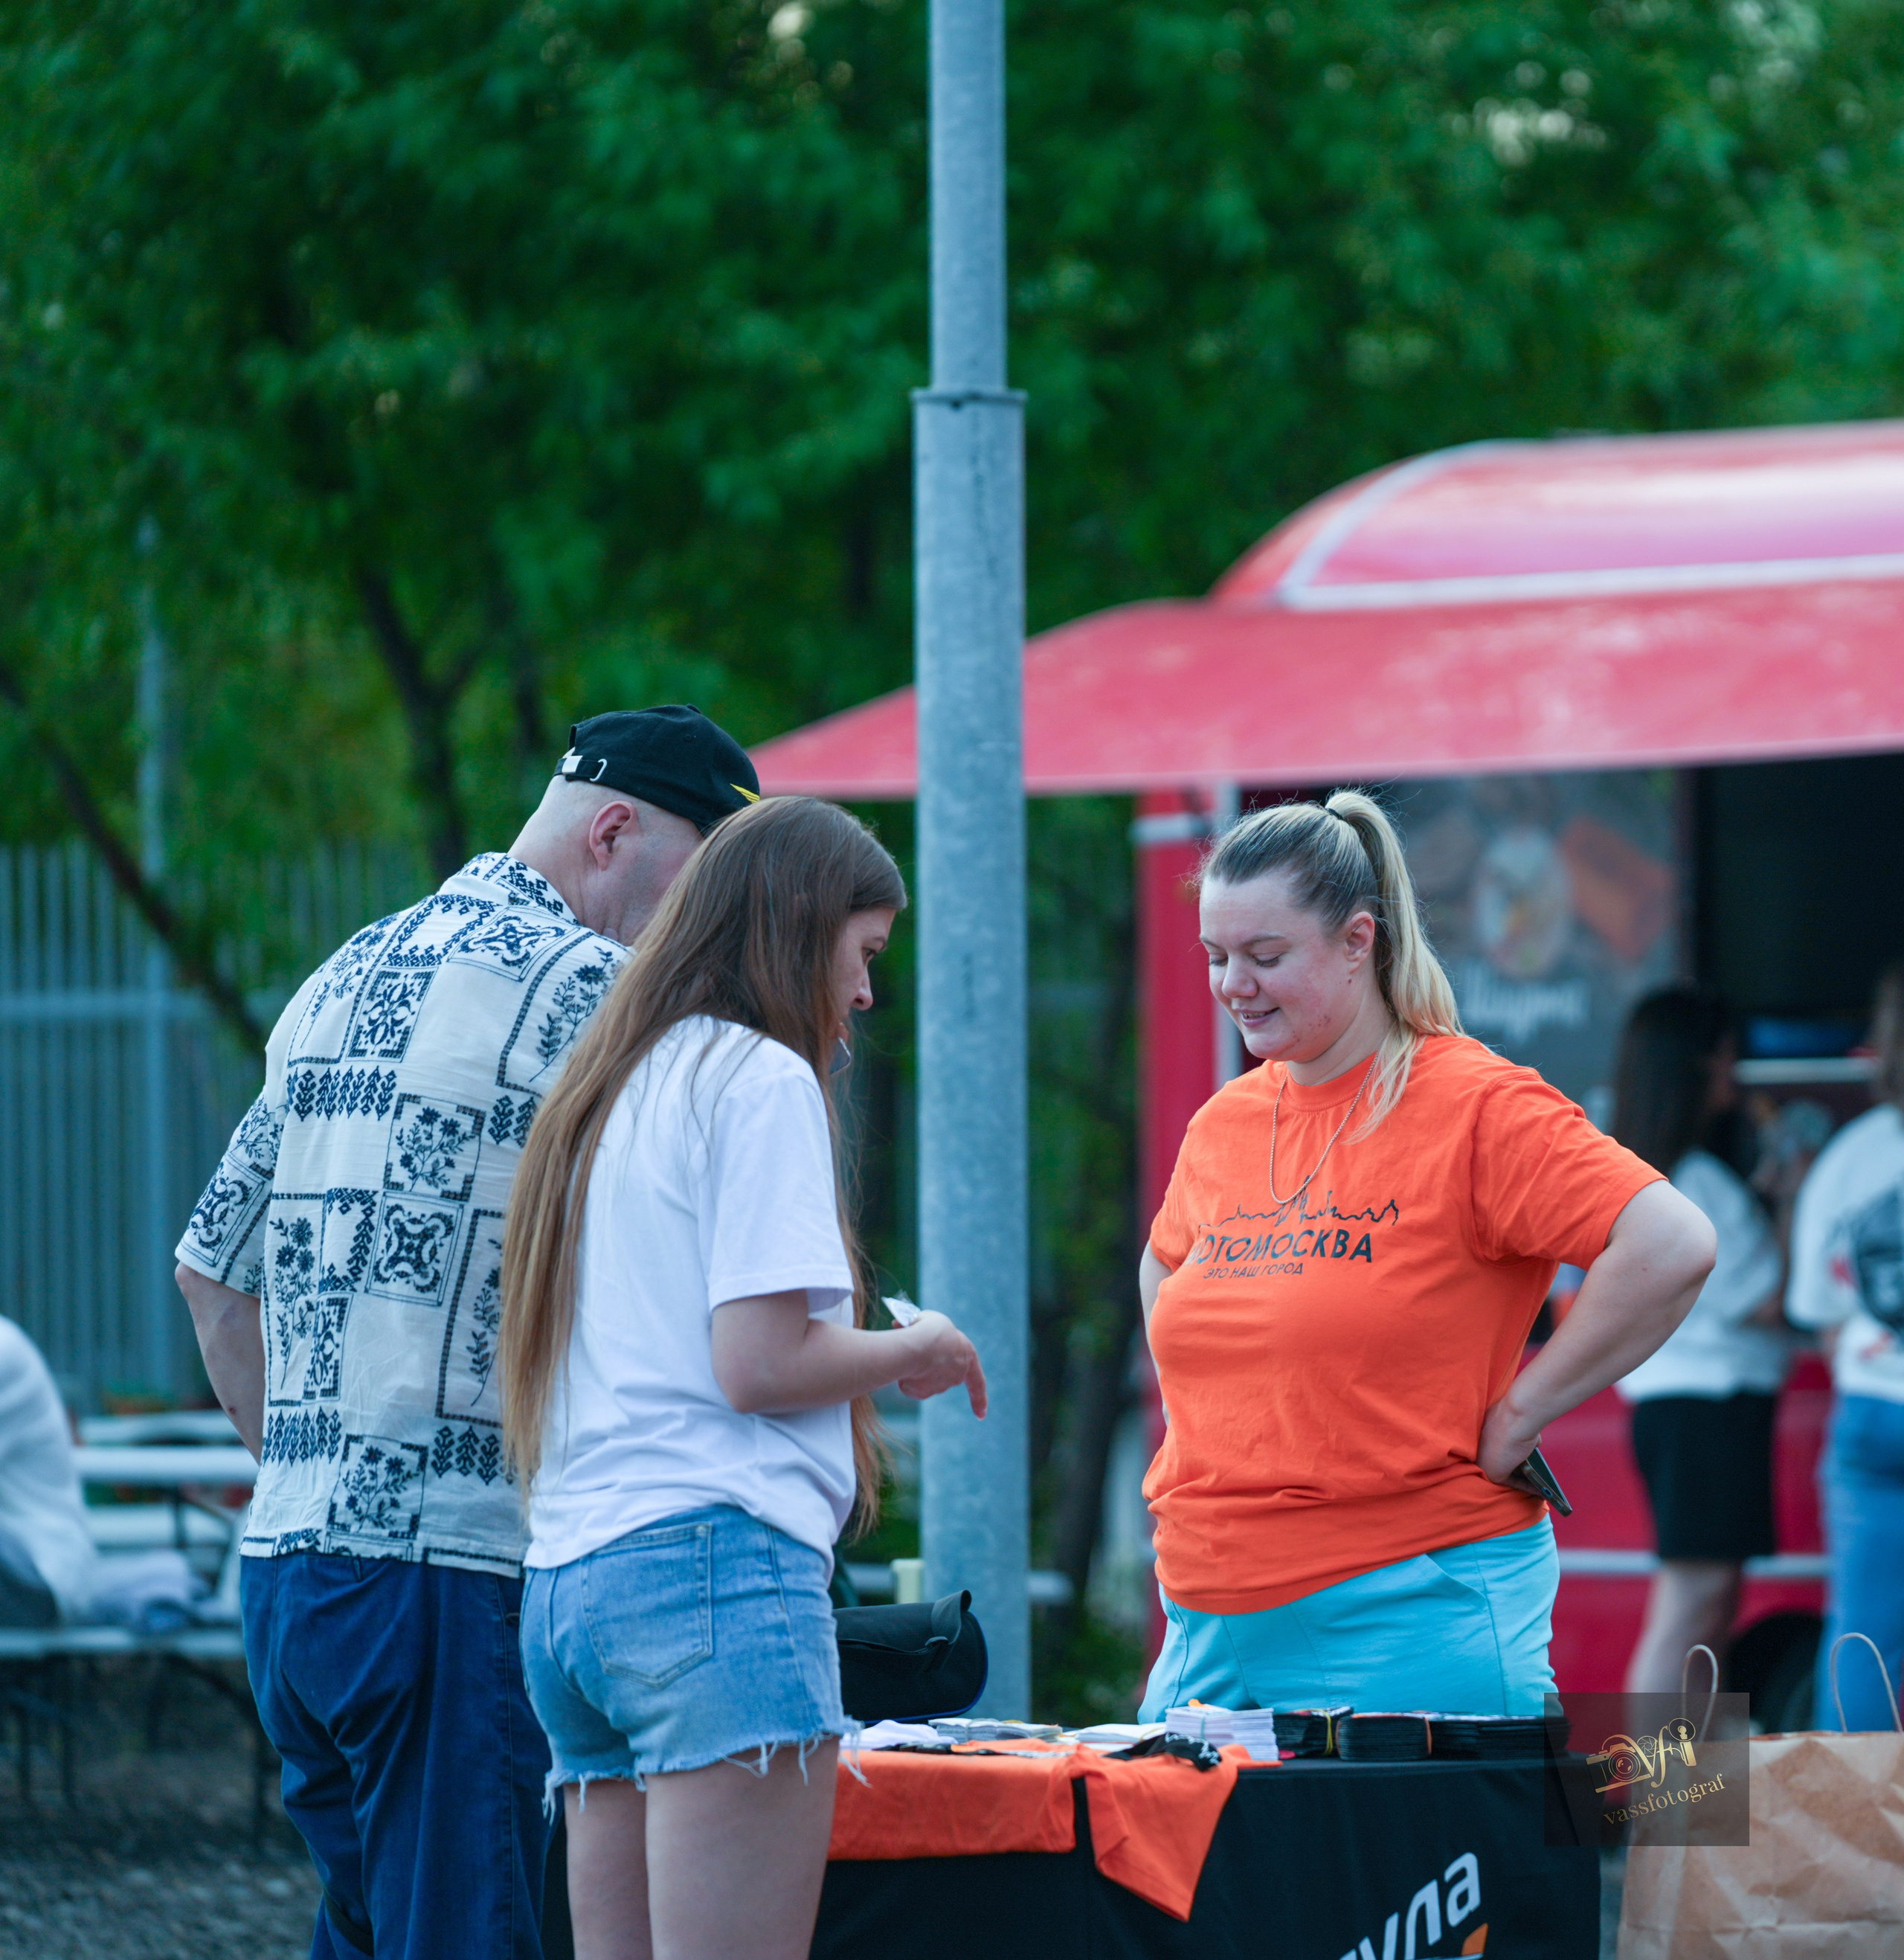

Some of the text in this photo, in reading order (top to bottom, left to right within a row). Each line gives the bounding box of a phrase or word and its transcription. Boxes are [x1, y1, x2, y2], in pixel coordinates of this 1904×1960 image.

[1203, 1262, 1304, 1279] ЭТО НАШ ГОРОД
